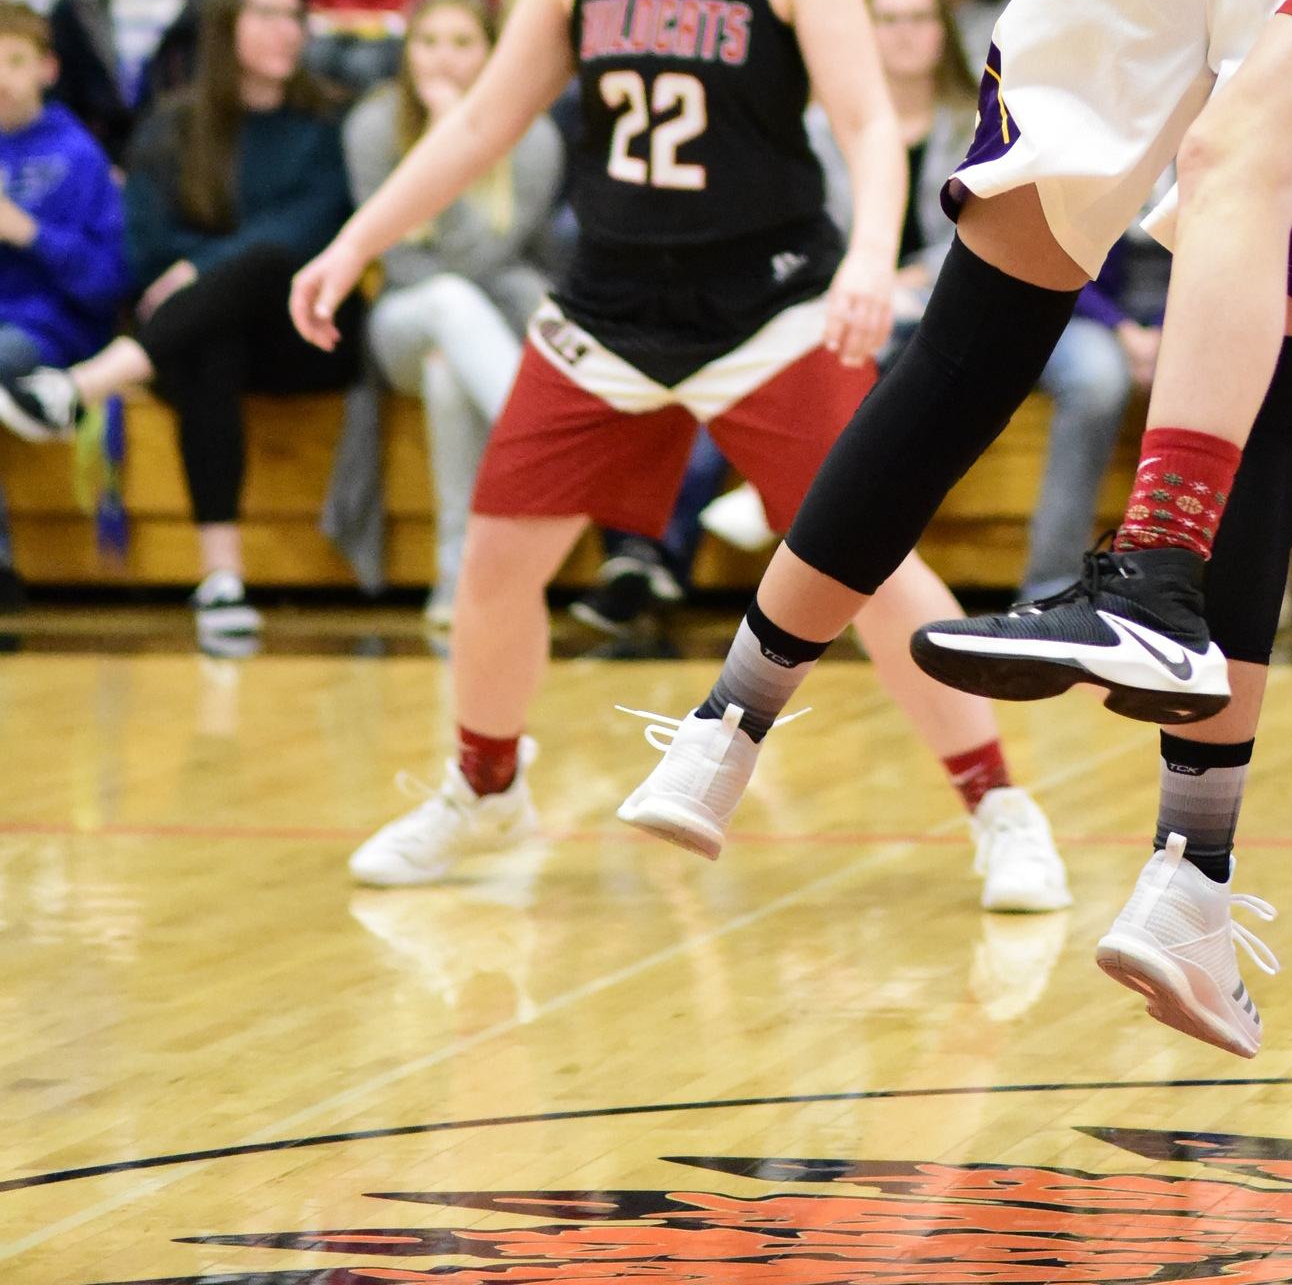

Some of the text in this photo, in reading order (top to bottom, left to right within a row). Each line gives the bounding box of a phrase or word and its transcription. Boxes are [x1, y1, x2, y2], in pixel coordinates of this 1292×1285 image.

[599, 69, 708, 191] 22
[764, 647, 794, 667] TCK
[1169, 762, 1200, 775] TCK
